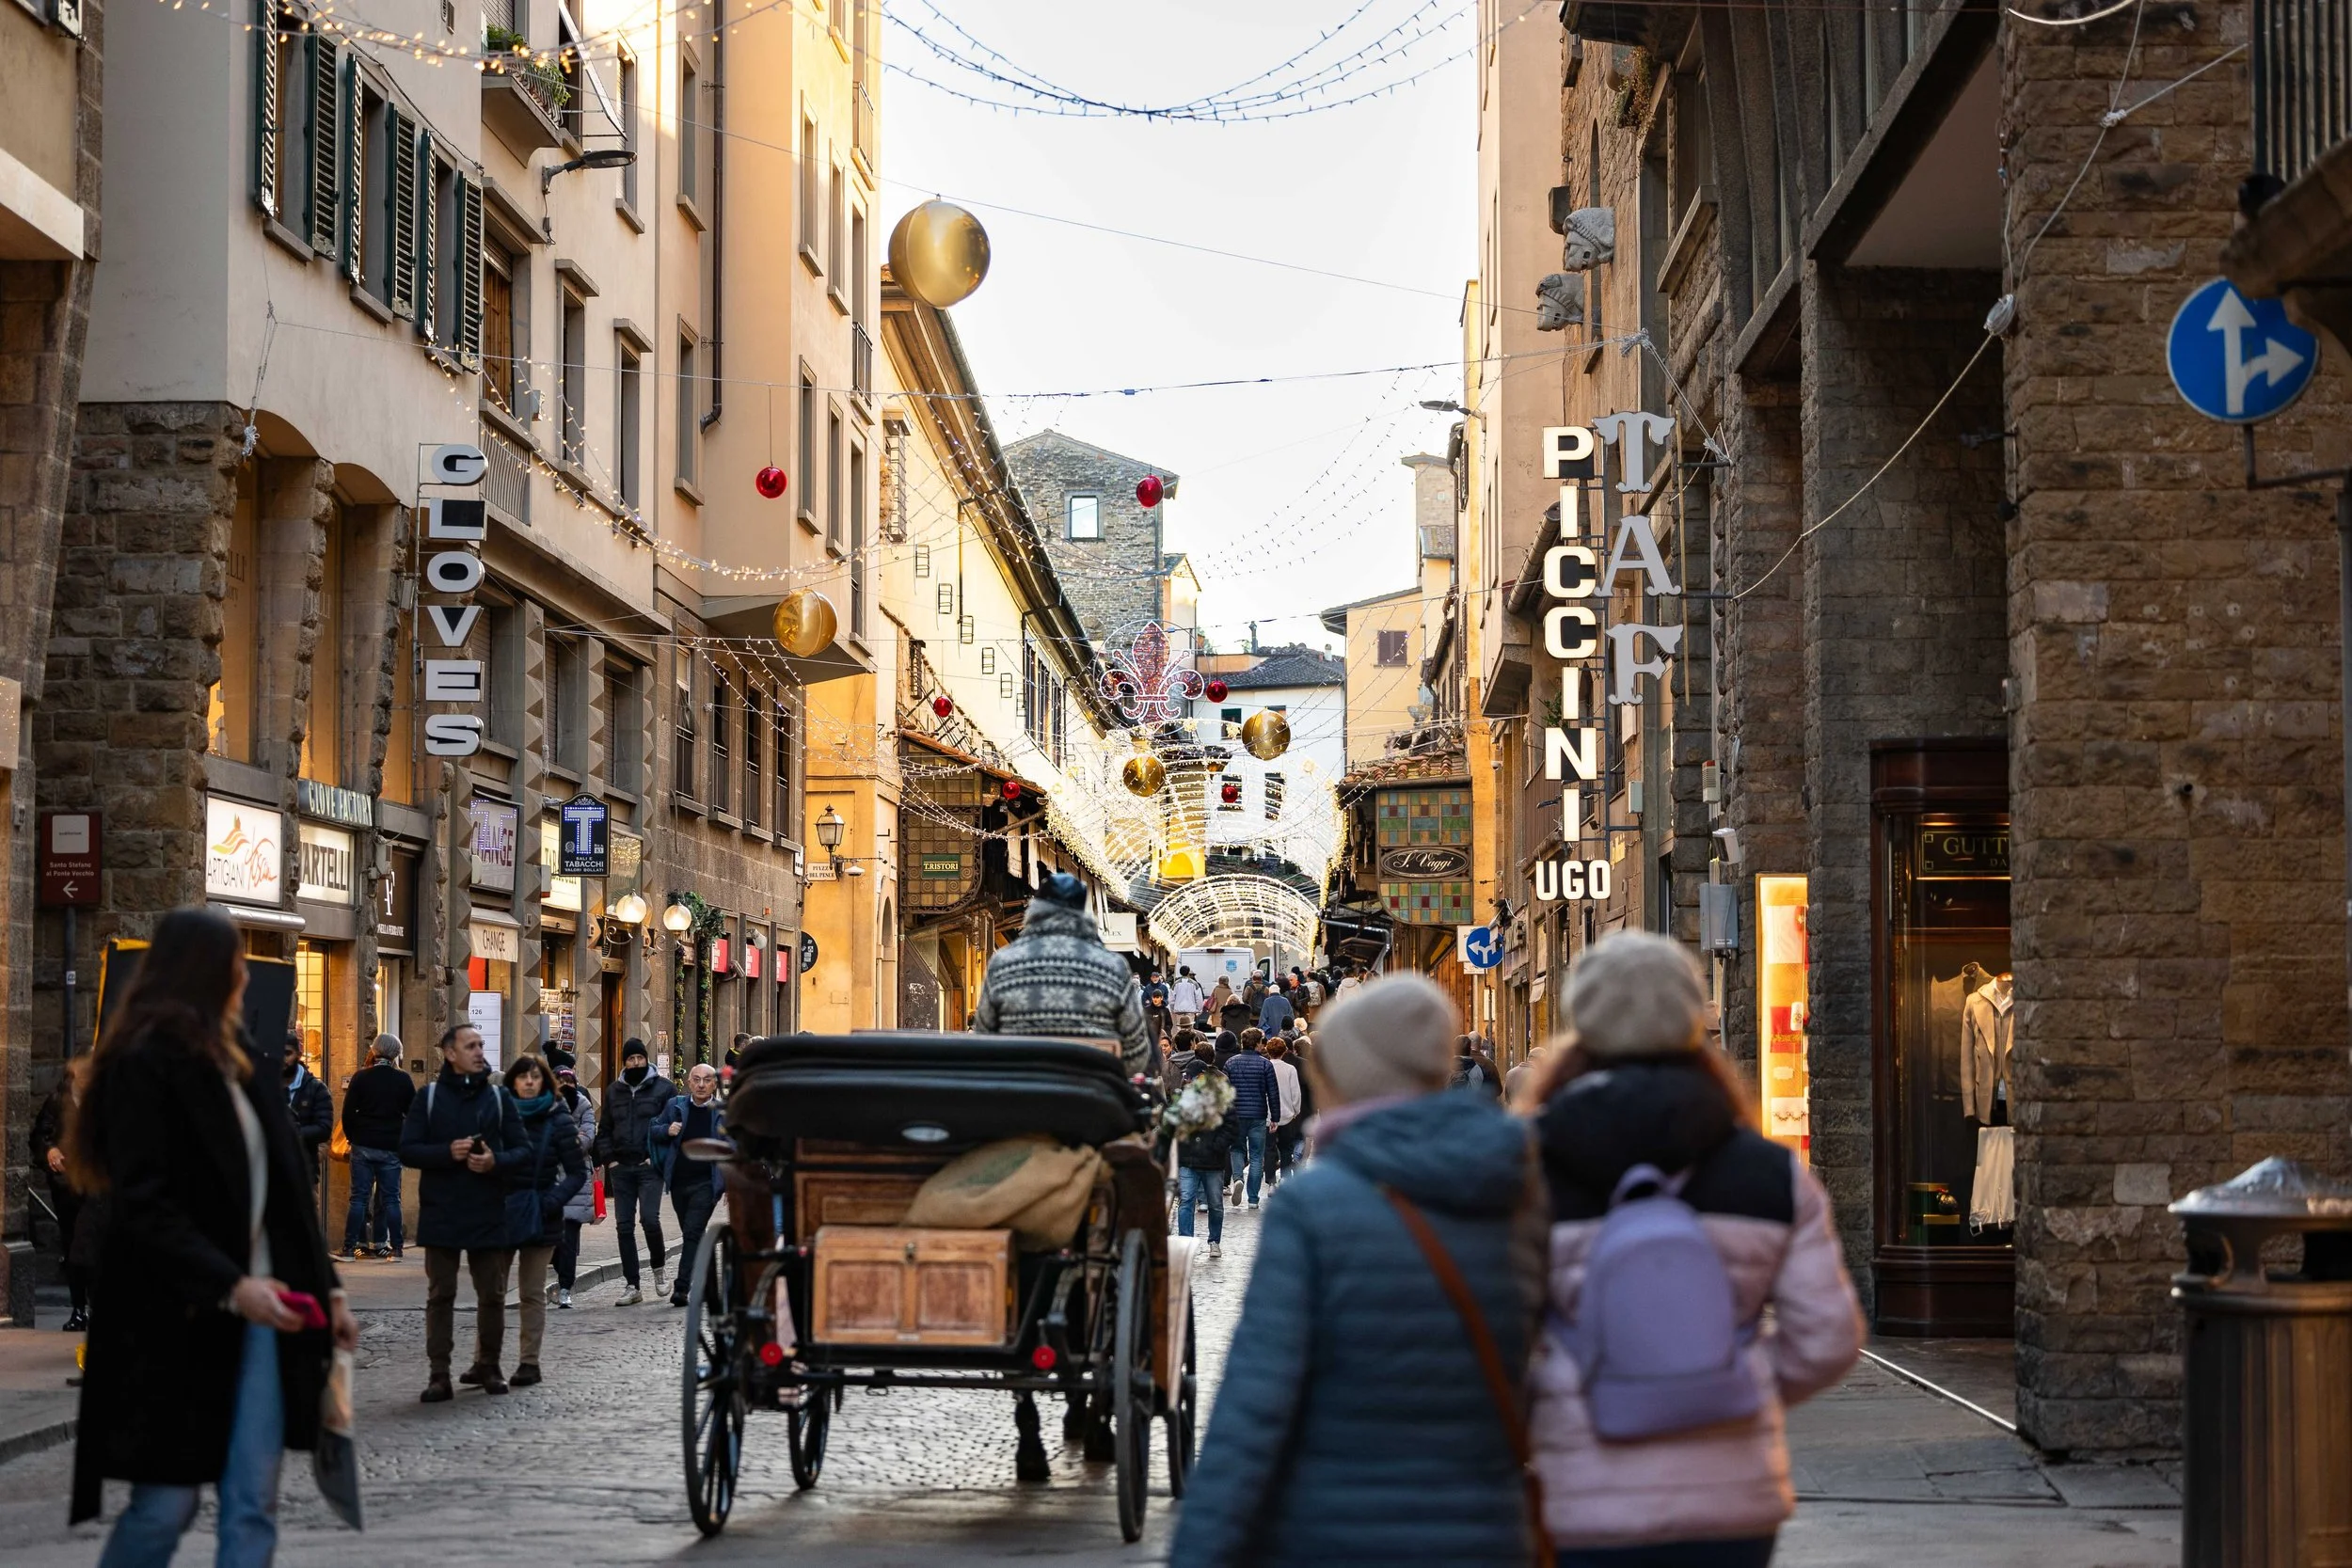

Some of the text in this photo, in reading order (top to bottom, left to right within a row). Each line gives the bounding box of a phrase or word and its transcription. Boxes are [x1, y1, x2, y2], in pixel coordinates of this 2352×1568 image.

[1592, 411, 1683, 705] TAF
[425, 443, 488, 756] GLOVES
[1543, 426, 1597, 841] PICCINI
[309, 780, 373, 827] GLOVE FACTORY
[471, 820, 514, 867] CHANGE
[1416, 852, 1454, 871] Vaggi
[1943, 836, 2010, 856] GUTT
[207, 857, 245, 889] ARTIGIANI
[1535, 859, 1612, 901] UGO
[483, 928, 506, 952] CHANGE
